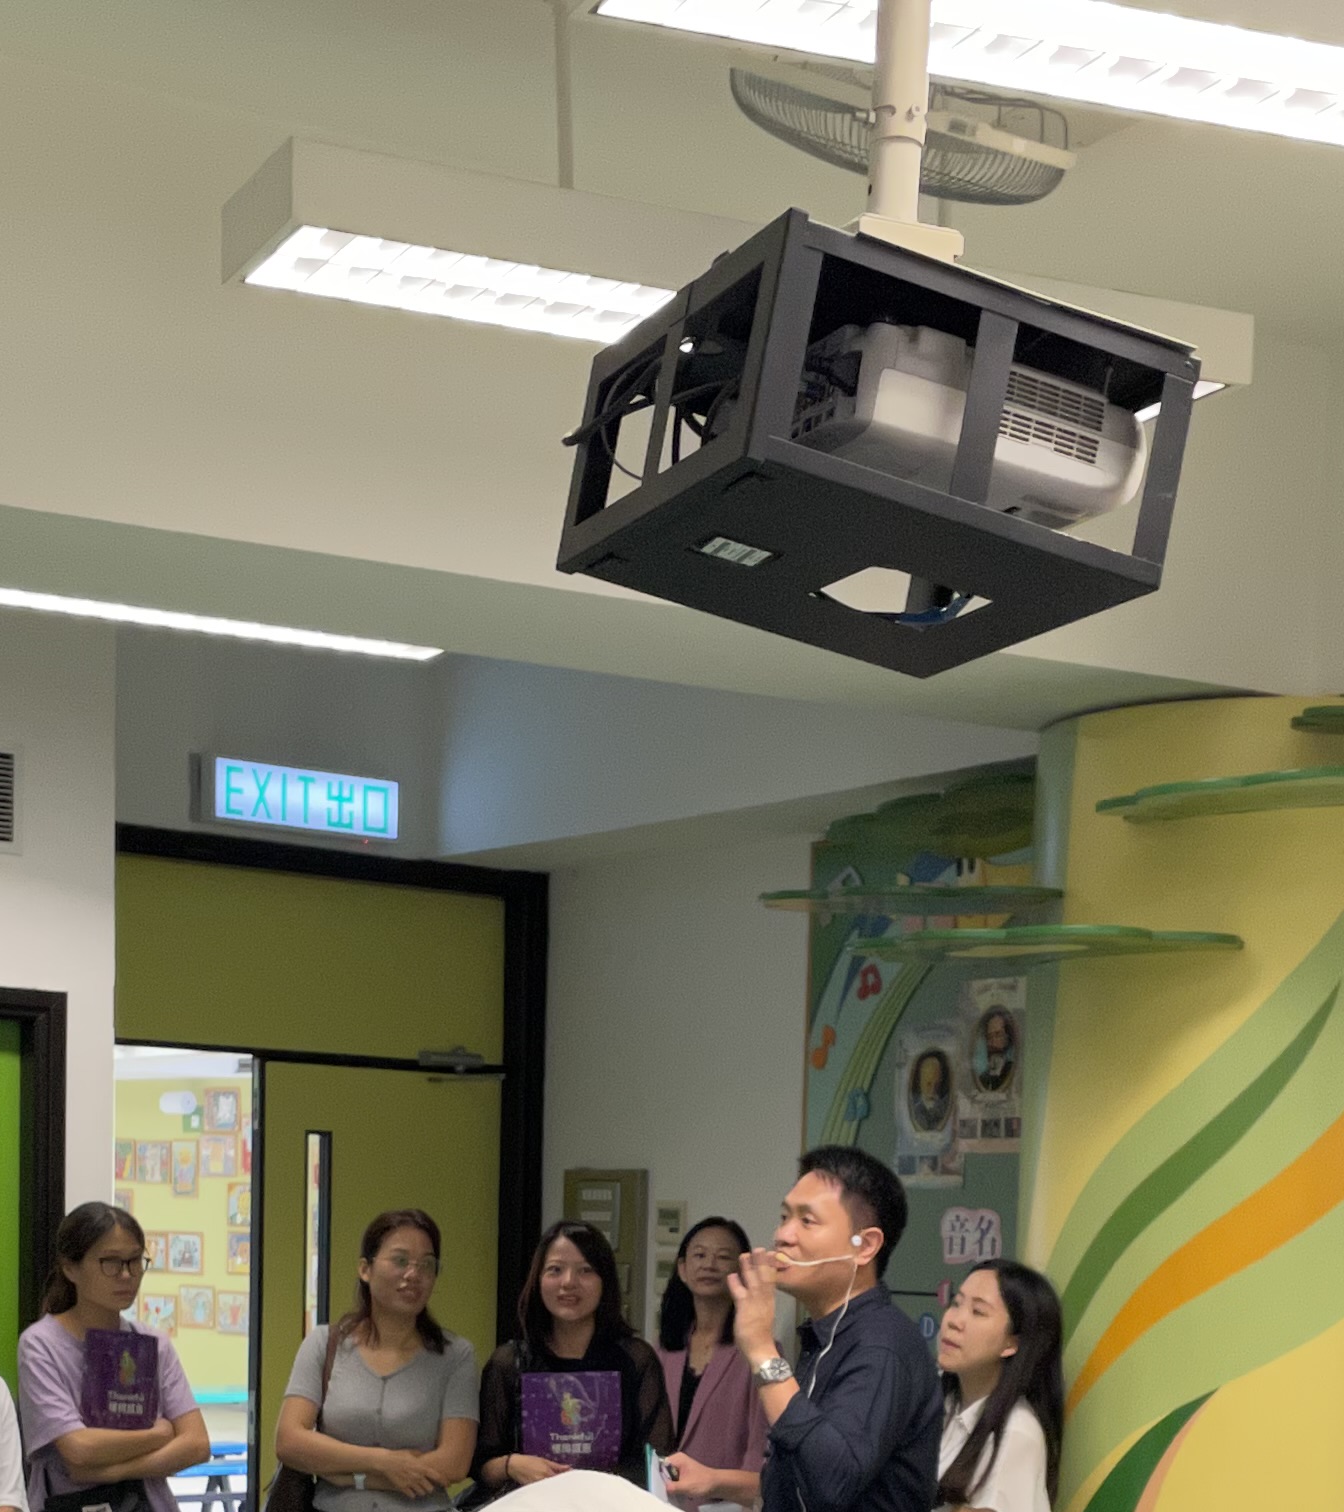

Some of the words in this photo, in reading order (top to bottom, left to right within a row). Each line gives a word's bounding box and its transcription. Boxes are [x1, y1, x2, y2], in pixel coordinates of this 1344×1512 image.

[225, 765, 316, 824] EXIT
[327, 780, 390, 834] 出口
[947, 1214, 998, 1256] 音名
[923, 1316, 935, 1337] D
